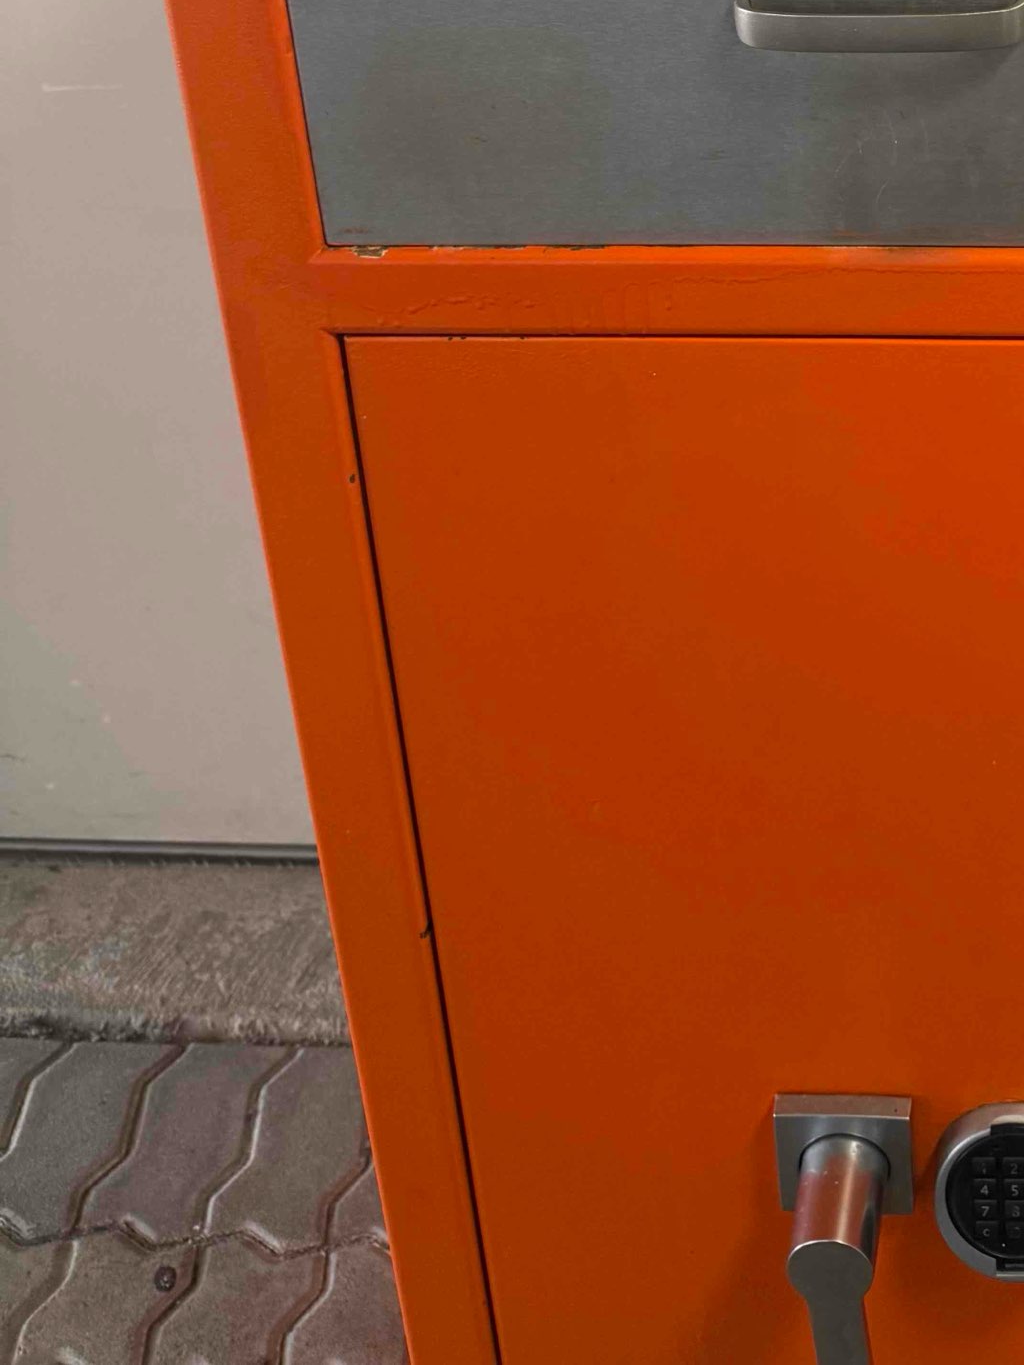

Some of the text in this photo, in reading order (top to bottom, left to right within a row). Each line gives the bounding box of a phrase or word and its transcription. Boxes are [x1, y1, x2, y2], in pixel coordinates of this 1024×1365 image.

[1009, 1162, 1018, 1175] 2
[980, 1184, 989, 1196] 4
[1011, 1184, 1019, 1196] 5
[980, 1205, 990, 1217] 7
